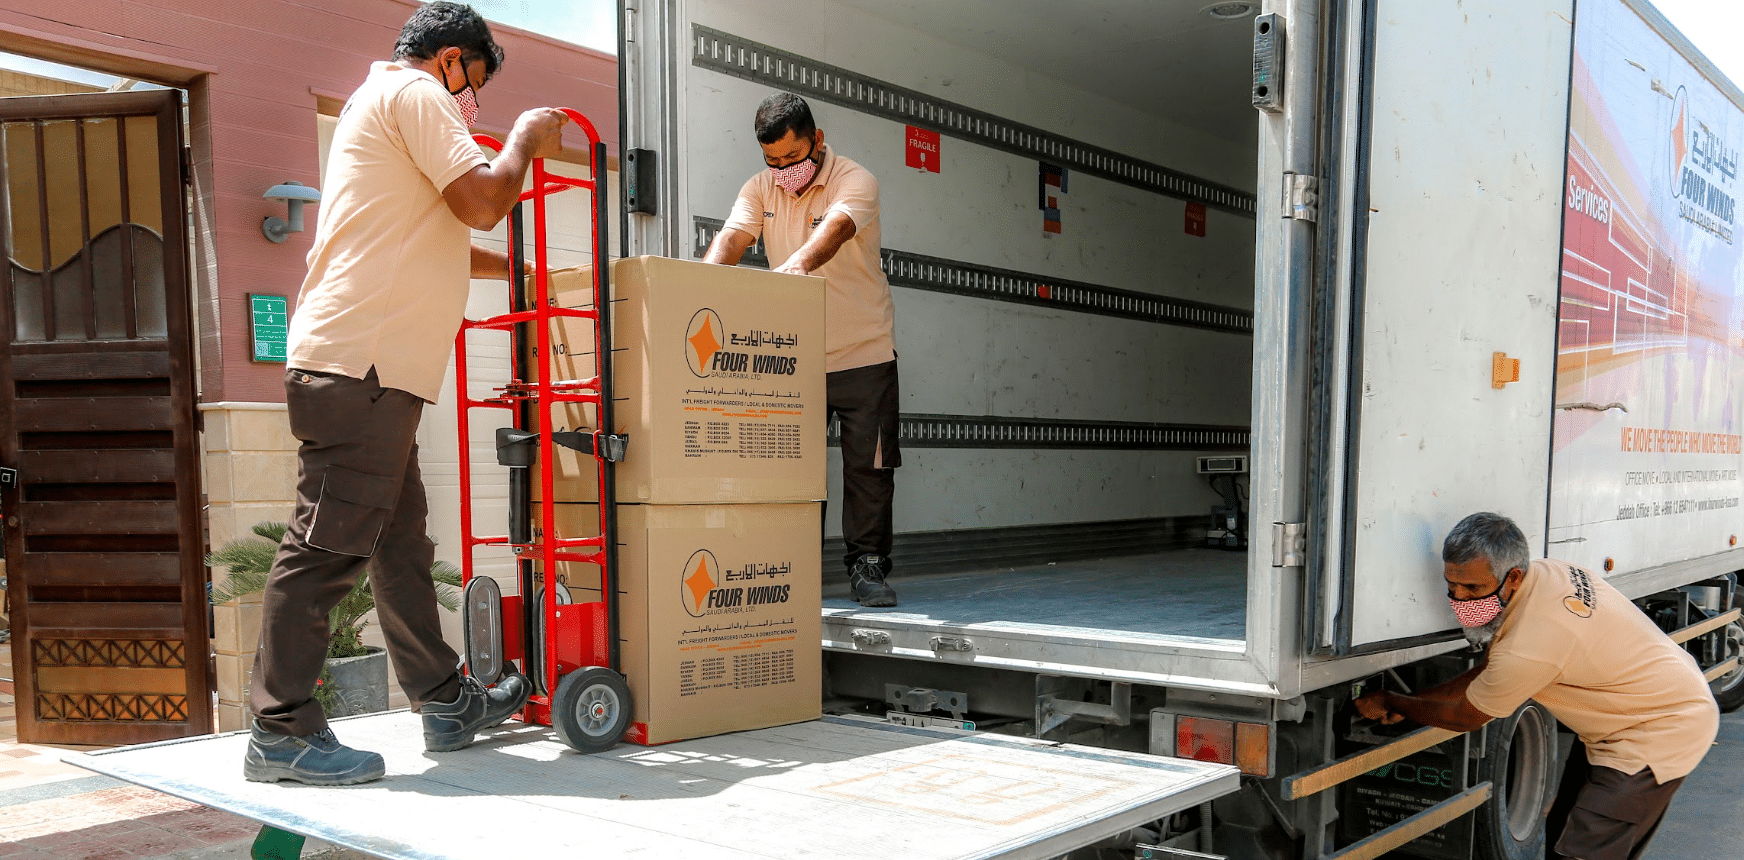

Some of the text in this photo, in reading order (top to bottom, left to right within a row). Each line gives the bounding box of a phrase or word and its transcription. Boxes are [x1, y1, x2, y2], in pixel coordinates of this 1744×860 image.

[910, 138, 936, 152] FRAGILE
[1568, 174, 1608, 224] Services
[1681, 166, 1736, 226] FOUR WINDS
[266, 314, 273, 324] 4
[762, 331, 798, 349] الجهات
[553, 344, 568, 356] NO:
[712, 352, 797, 376] FOUR WINDS
[1621, 427, 1632, 452] WE
[1633, 428, 1652, 452] MOVE
[1654, 429, 1665, 452] THE
[1666, 430, 1688, 453] PEOPLE
[1689, 432, 1701, 453] WHO
[1702, 432, 1716, 454] MOVE
[1717, 434, 1726, 454] THE
[1625, 471, 1641, 485] OFFICE
[1643, 472, 1655, 485] MOVE
[1660, 471, 1673, 484] LOCAL
[1617, 504, 1634, 520] Jeddah
[1636, 503, 1649, 518] Office
[1673, 500, 1678, 514] 12
[757, 562, 791, 578] الجهات
[708, 584, 791, 608] FOUR WINDS
[1394, 762, 1452, 788] CGS
[1357, 787, 1381, 796] RIYADH
[1389, 793, 1415, 802] JEDDAH
[1375, 798, 1400, 808] KUWAIT
[1366, 808, 1379, 816] Tel.
